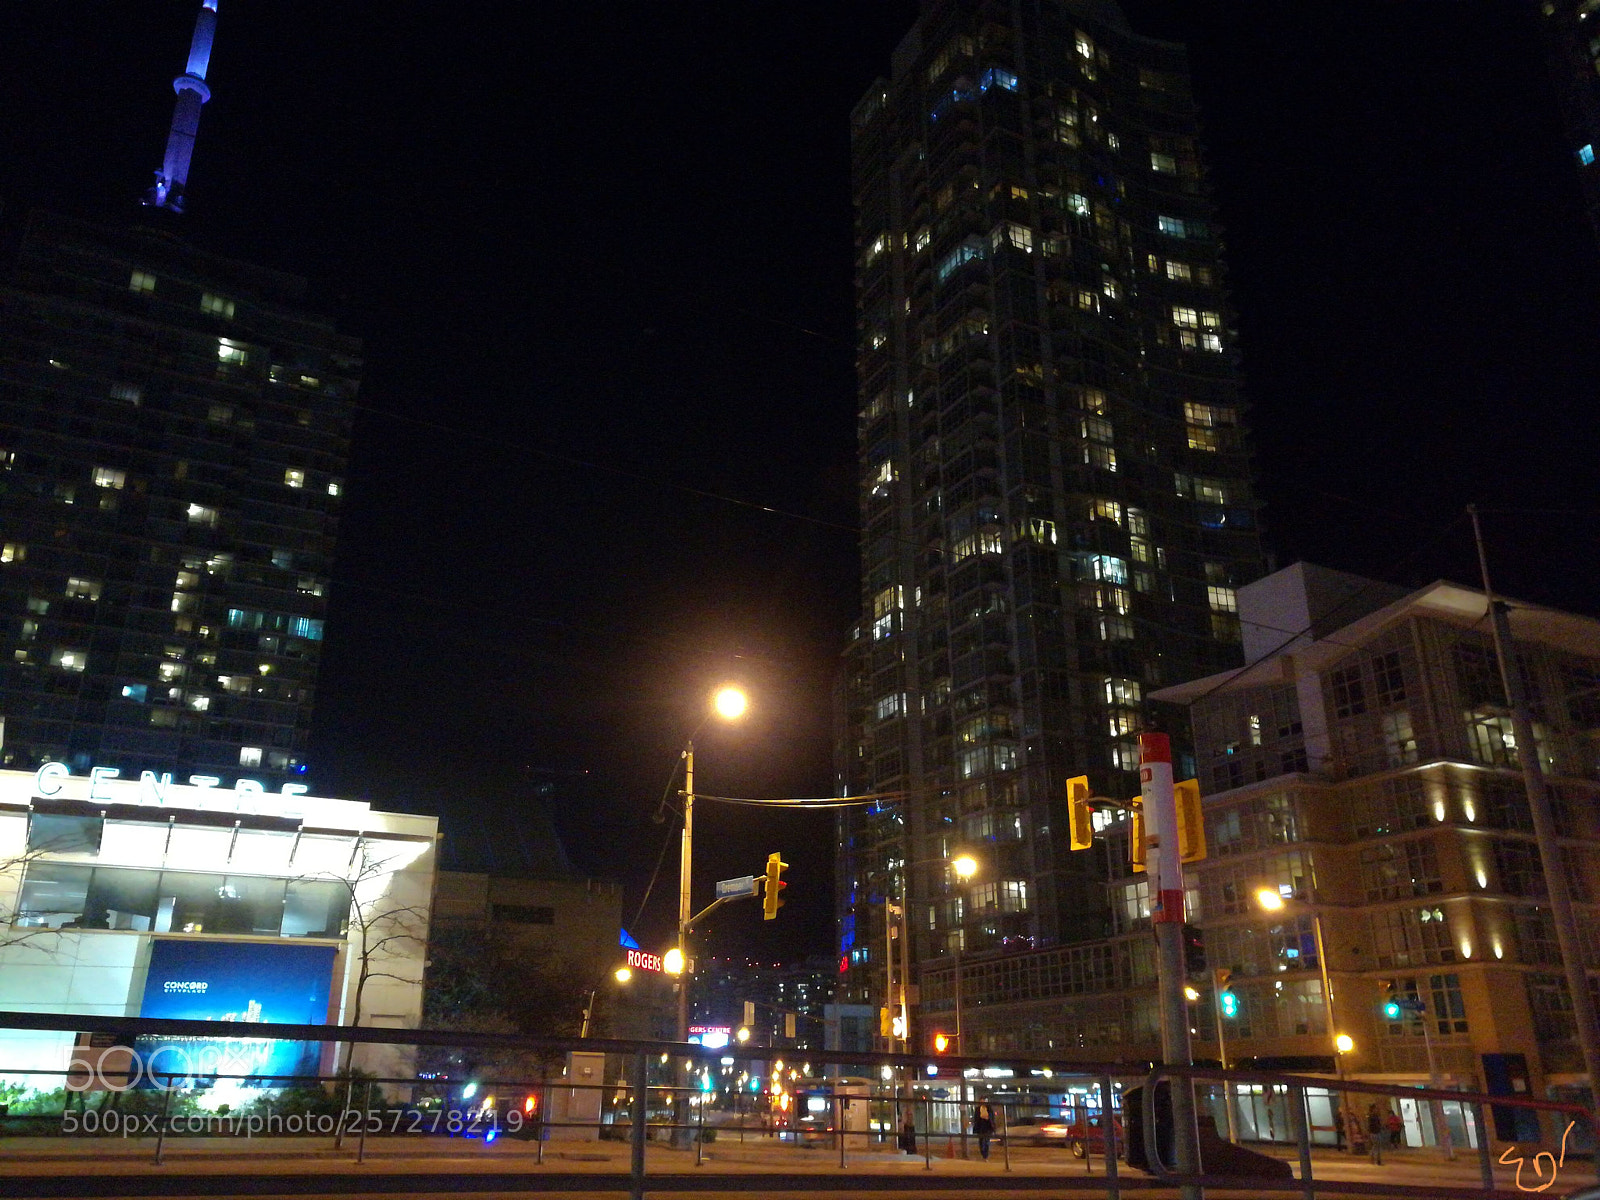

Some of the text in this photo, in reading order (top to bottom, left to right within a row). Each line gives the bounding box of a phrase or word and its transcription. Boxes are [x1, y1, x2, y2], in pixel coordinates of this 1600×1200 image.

[35, 761, 309, 815] CENTRE
[628, 950, 661, 972] ROGERS
[163, 981, 209, 989] CONCORD
